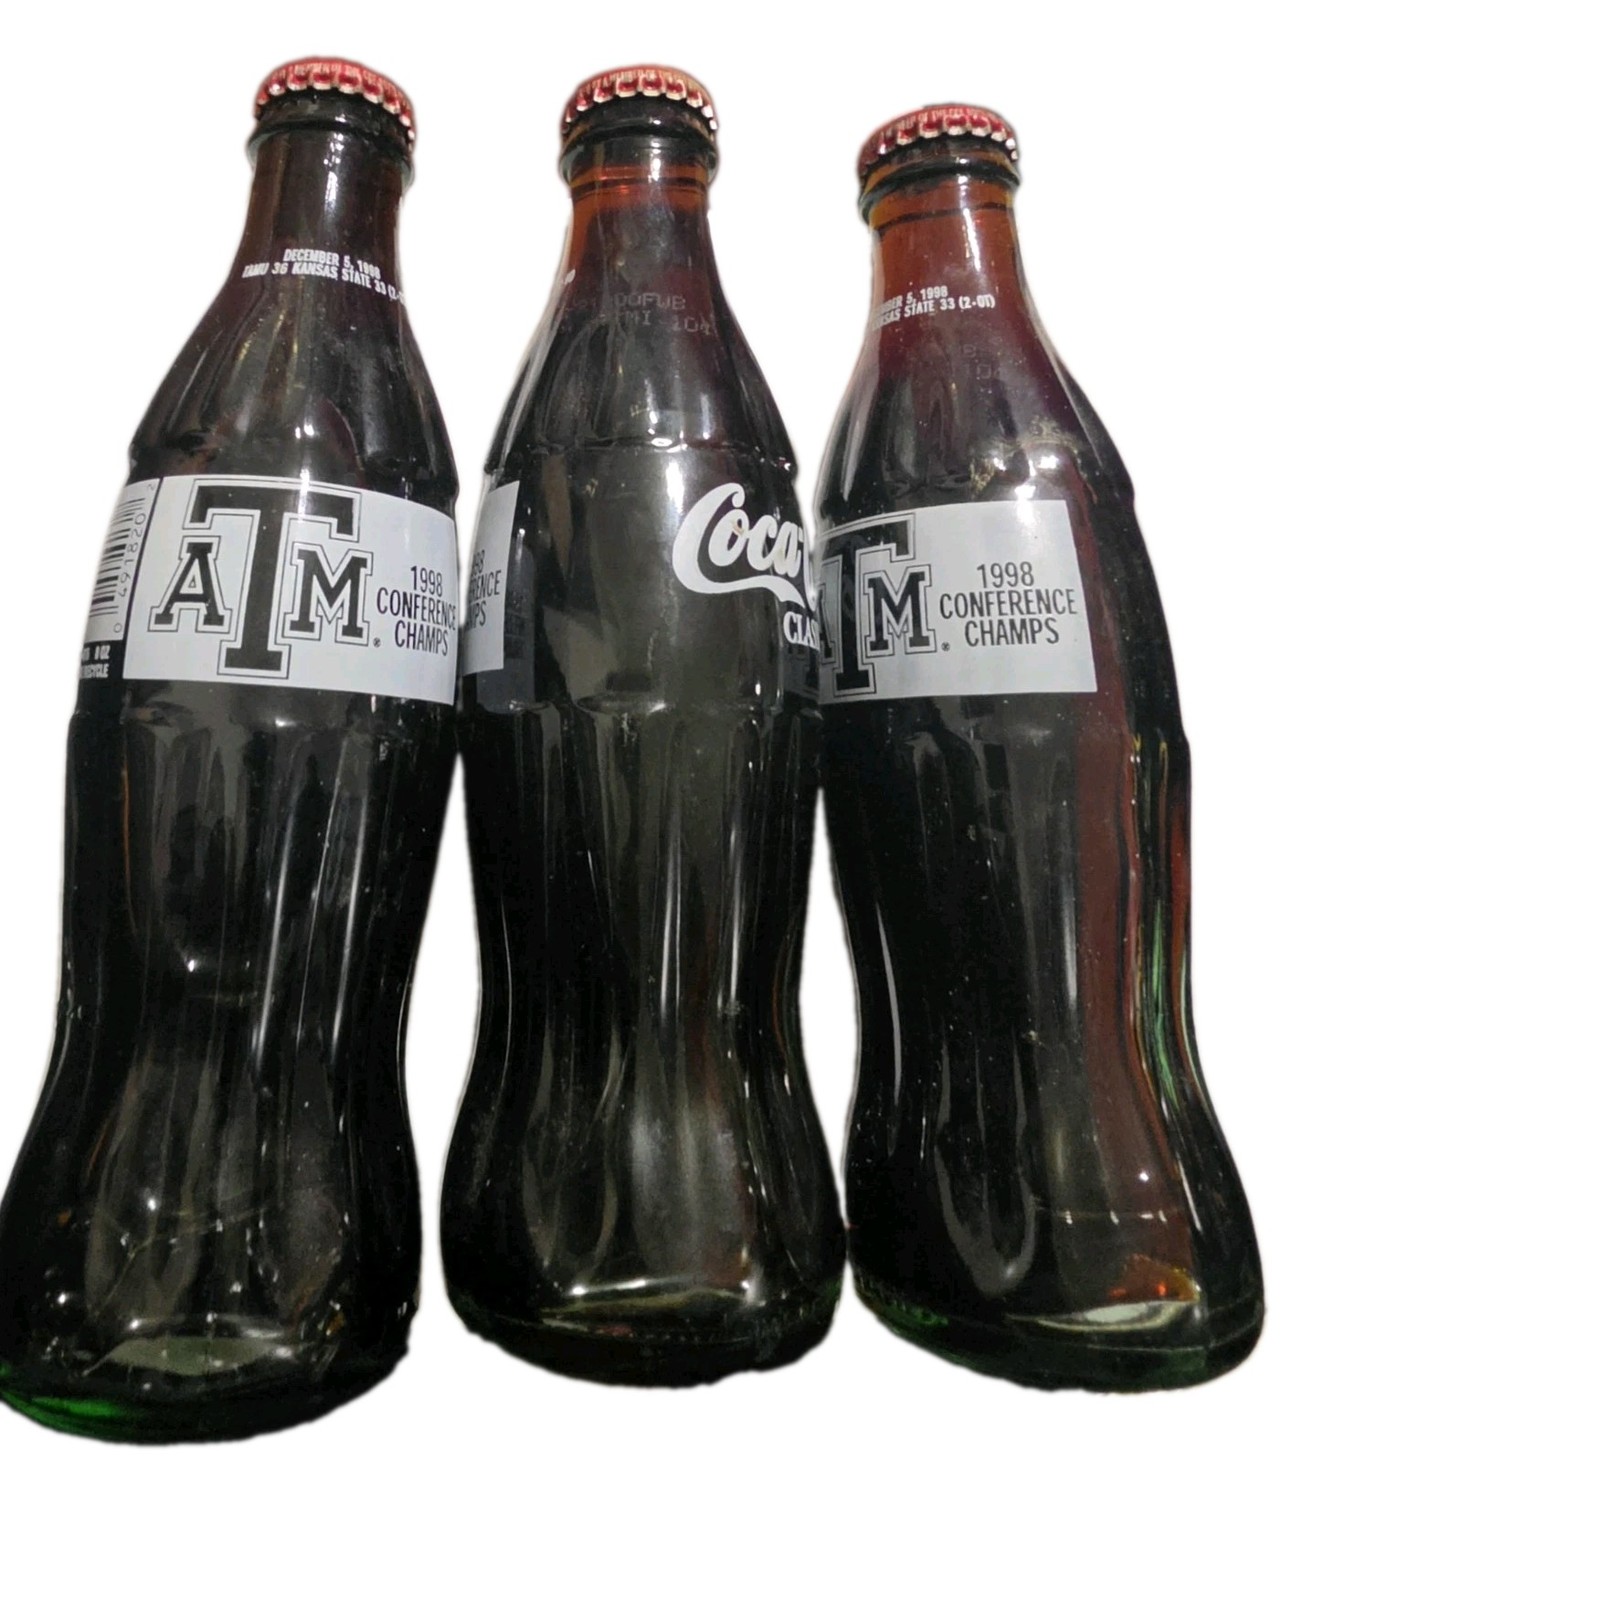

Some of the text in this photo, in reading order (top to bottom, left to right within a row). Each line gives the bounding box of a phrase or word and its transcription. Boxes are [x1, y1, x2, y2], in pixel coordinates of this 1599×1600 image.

[241, 262, 270, 279] TAMU
[271, 262, 288, 275] 36
[291, 262, 338, 281] KANSAS
[341, 268, 372, 288] STATE
[374, 279, 387, 295] 33
[283, 248, 381, 279] DECEMBER 5, 1998
[904, 300, 935, 318] STATE
[940, 298, 955, 311] 33
[906, 291, 917, 305] 5,
[920, 285, 948, 300] 1998
[411, 565, 443, 597] 1998
[976, 561, 1035, 589] 1998
[377, 587, 457, 631] CONFERENCE
[939, 588, 1078, 620] CONFERENCE
[394, 620, 449, 656] CHAMPS
[964, 617, 1060, 647] CHAMPS
